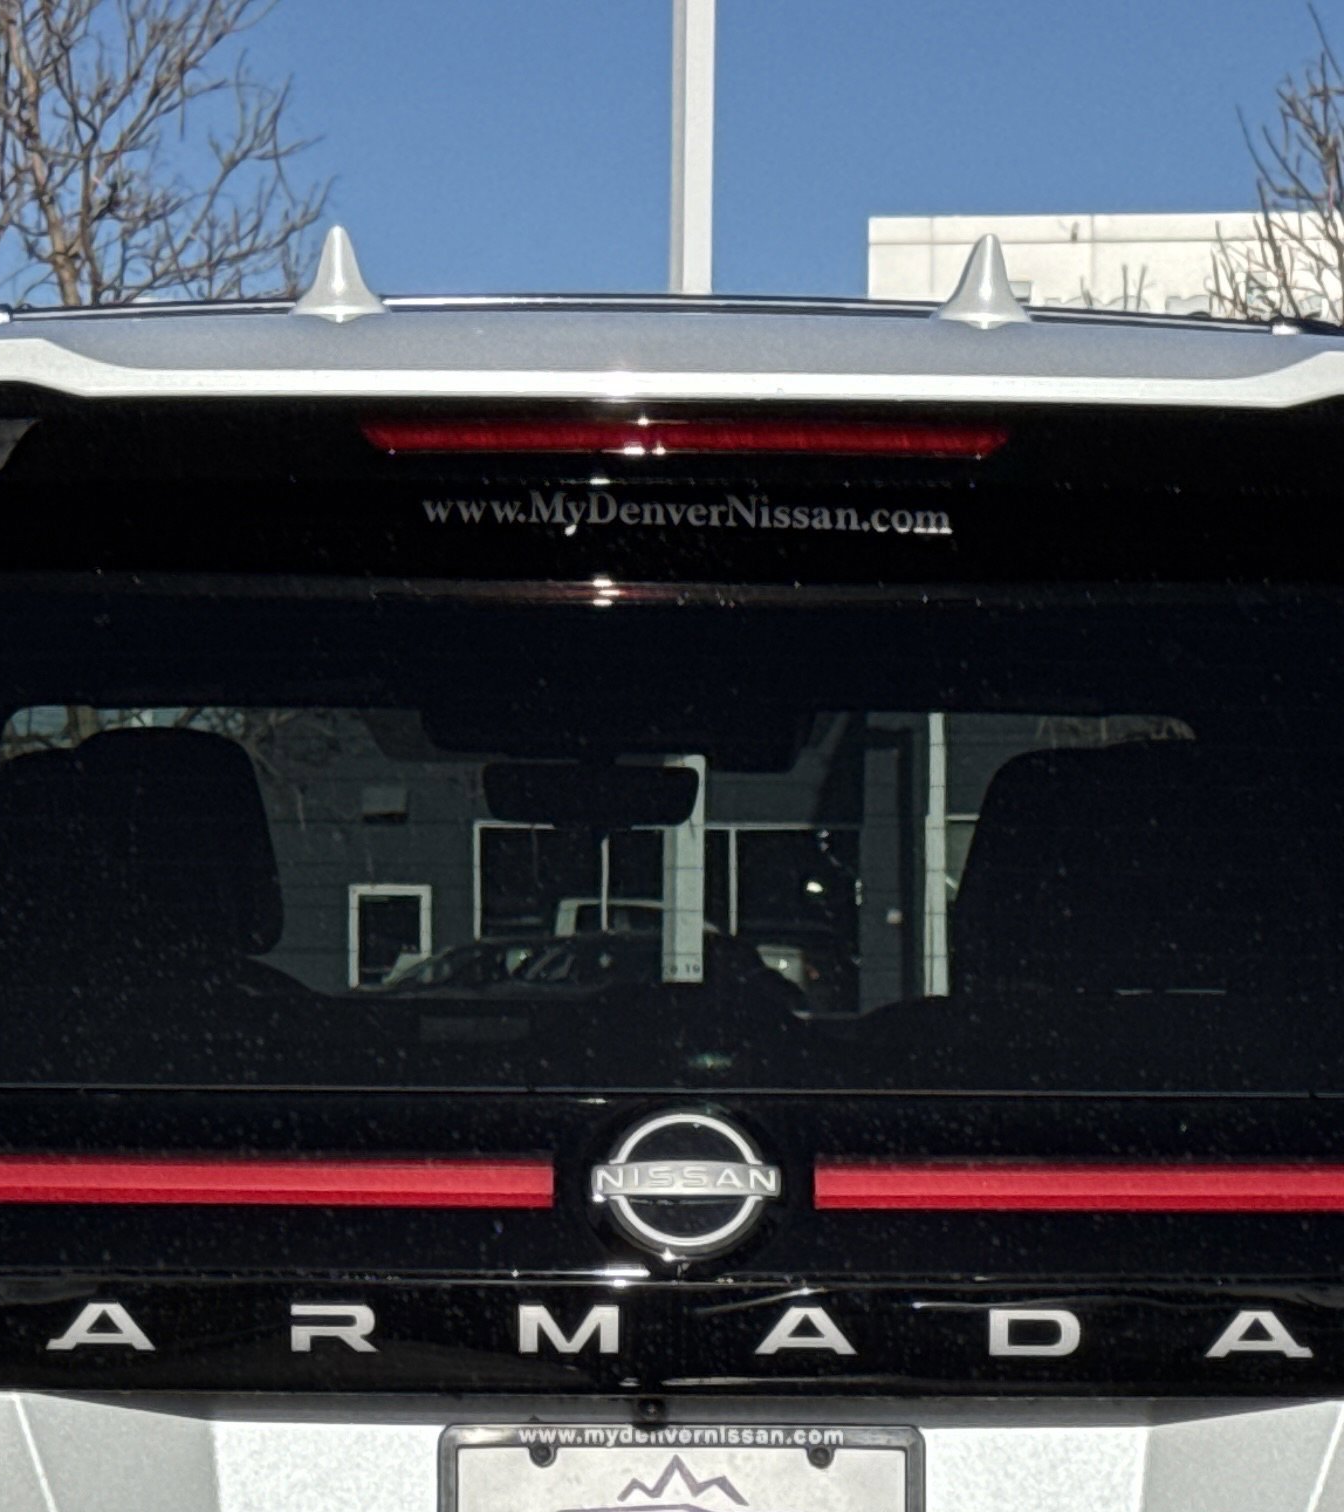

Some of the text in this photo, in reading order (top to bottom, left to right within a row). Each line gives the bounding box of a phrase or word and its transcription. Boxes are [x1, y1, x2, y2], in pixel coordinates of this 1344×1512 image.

[423, 491, 952, 535] www.MyDenverNissan.com
[596, 1167, 777, 1192] NISSAN
[45, 1301, 1314, 1359] ARMADA
